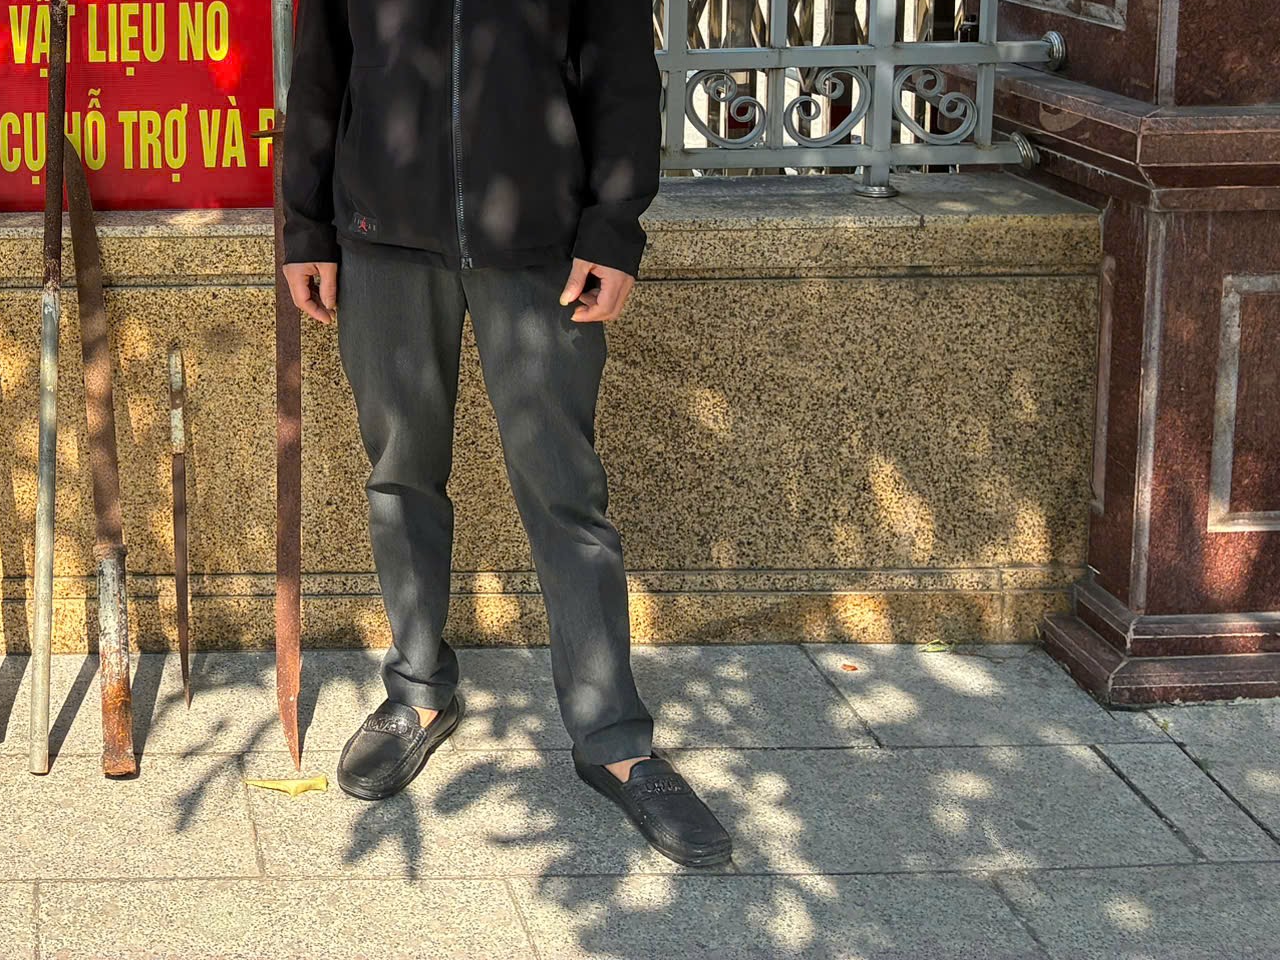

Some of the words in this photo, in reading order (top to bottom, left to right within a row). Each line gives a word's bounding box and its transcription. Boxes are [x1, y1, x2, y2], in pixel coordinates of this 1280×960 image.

[0, 111, 46, 184] CỤ
[117, 103, 188, 182] TRỢ
[199, 95, 246, 167] VÀ
